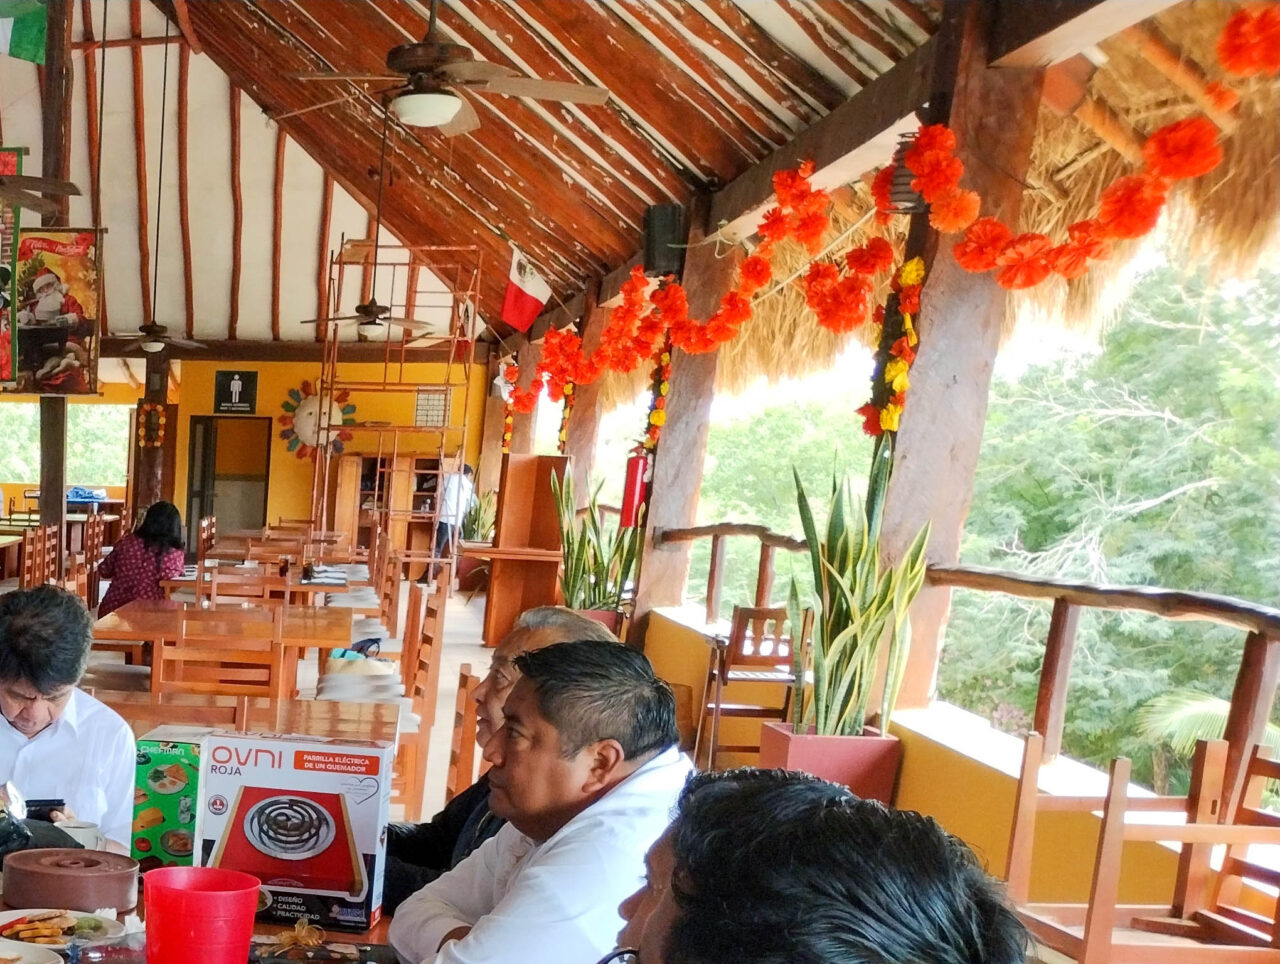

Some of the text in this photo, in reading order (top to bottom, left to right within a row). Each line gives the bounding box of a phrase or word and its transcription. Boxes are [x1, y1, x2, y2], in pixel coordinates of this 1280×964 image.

[140, 745, 185, 756] CHEFMAN
[335, 756, 370, 765] ELÉCTRICA
[210, 765, 242, 776] ROJA
[326, 764, 366, 772] QUEMADOR
[277, 911, 320, 920] PRACTICIDAD
